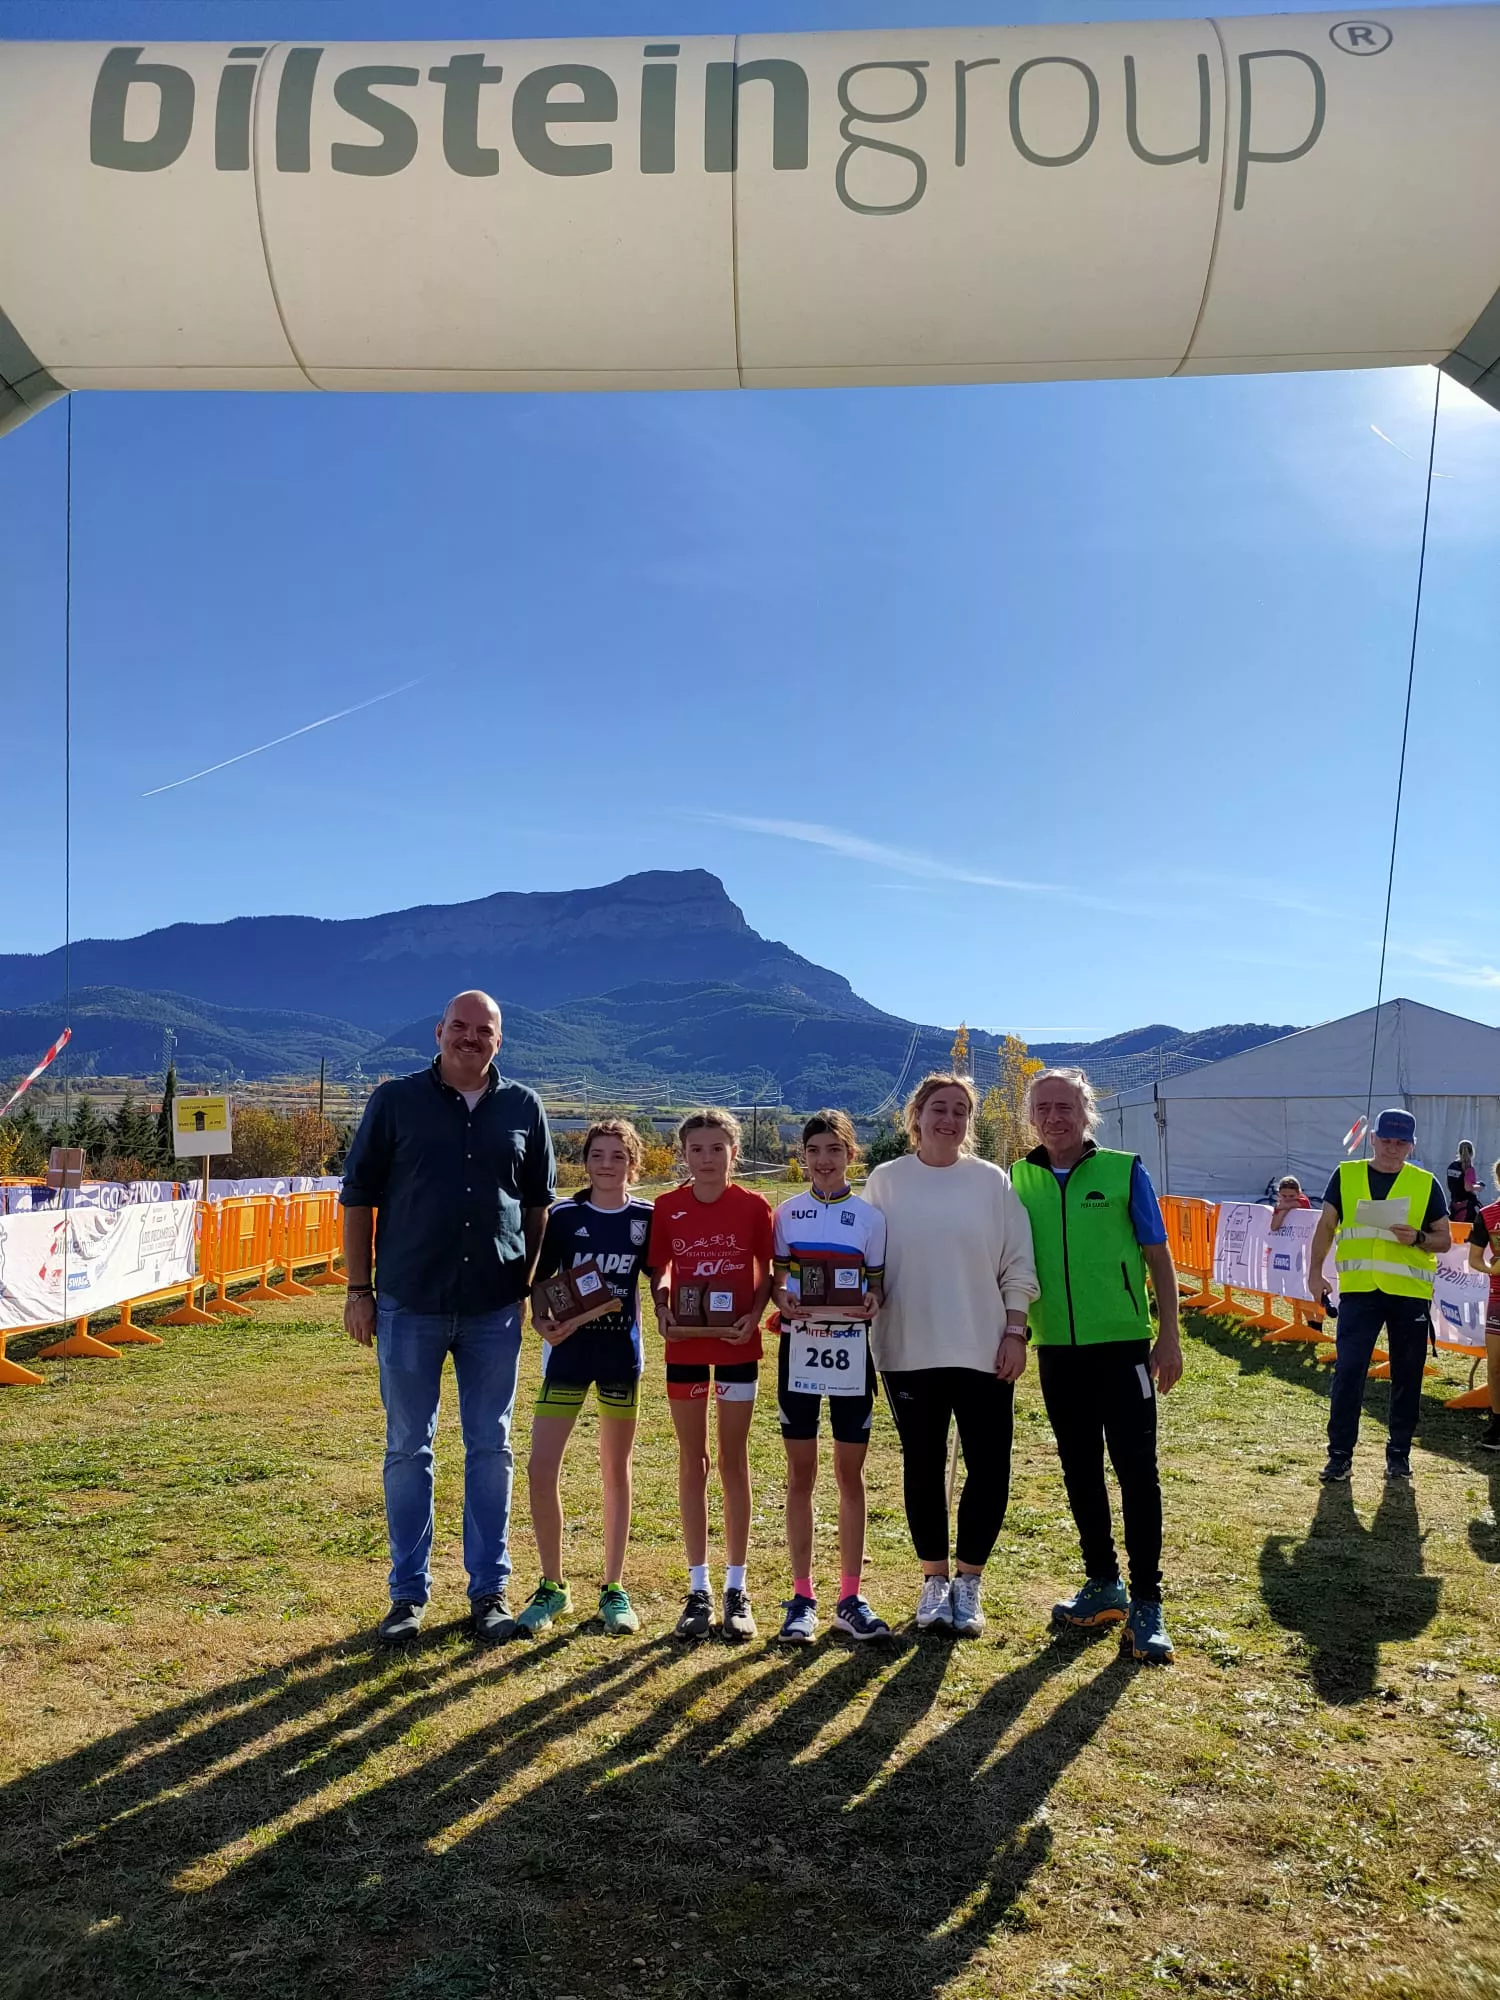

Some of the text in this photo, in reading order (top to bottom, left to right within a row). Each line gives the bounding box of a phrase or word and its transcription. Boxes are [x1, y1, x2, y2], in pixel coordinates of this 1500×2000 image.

[100, 1180, 161, 1210] GOERNO
[796, 1209, 817, 1220] UCI
[572, 1252, 637, 1274] MAPEI
[804, 1347, 850, 1371] 268
